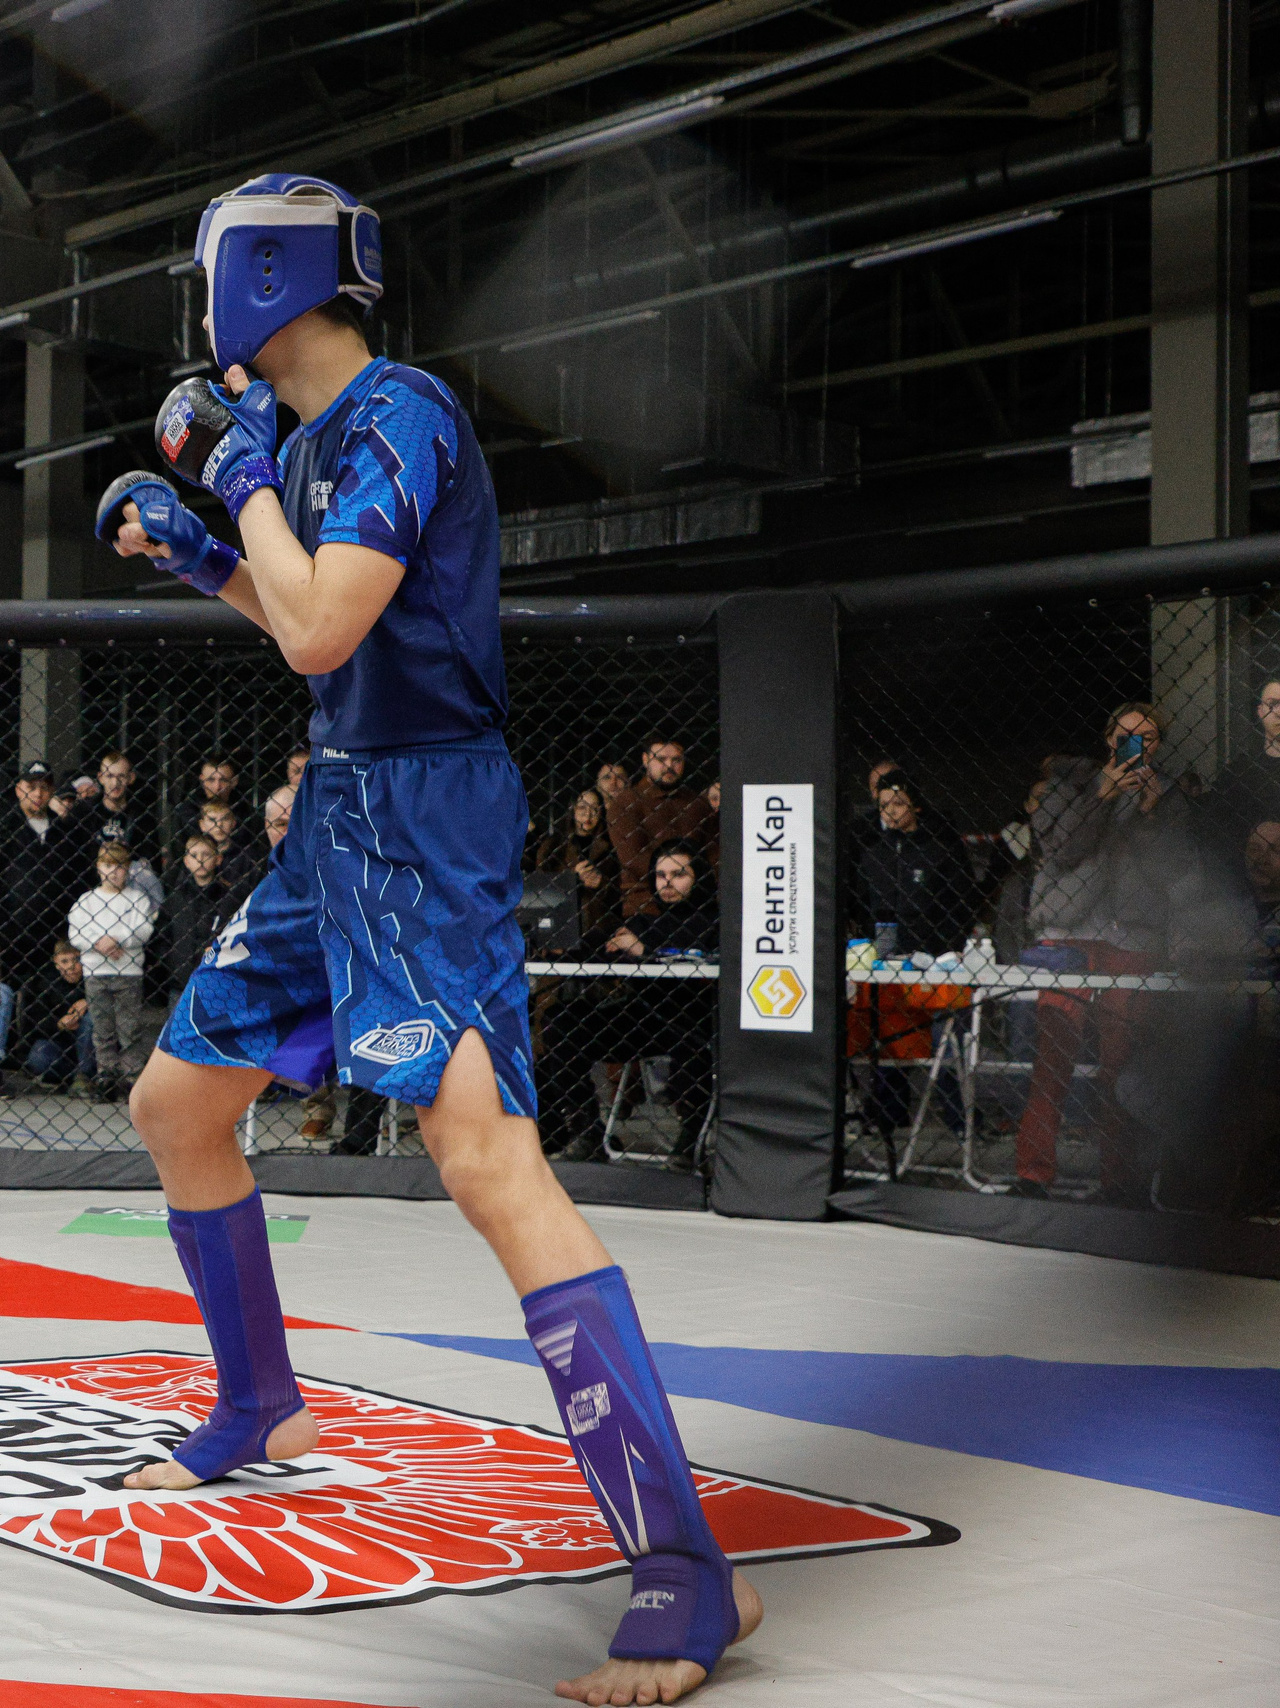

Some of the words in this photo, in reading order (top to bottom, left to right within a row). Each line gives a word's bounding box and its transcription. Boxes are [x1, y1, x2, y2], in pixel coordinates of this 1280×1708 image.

[202, 435, 231, 484] GREEN
[208, 448, 230, 490] HILL
[756, 796, 792, 852] Кар
[788, 842, 799, 915] спецтехники
[755, 865, 785, 954] Рента
[788, 917, 799, 954] услуги
